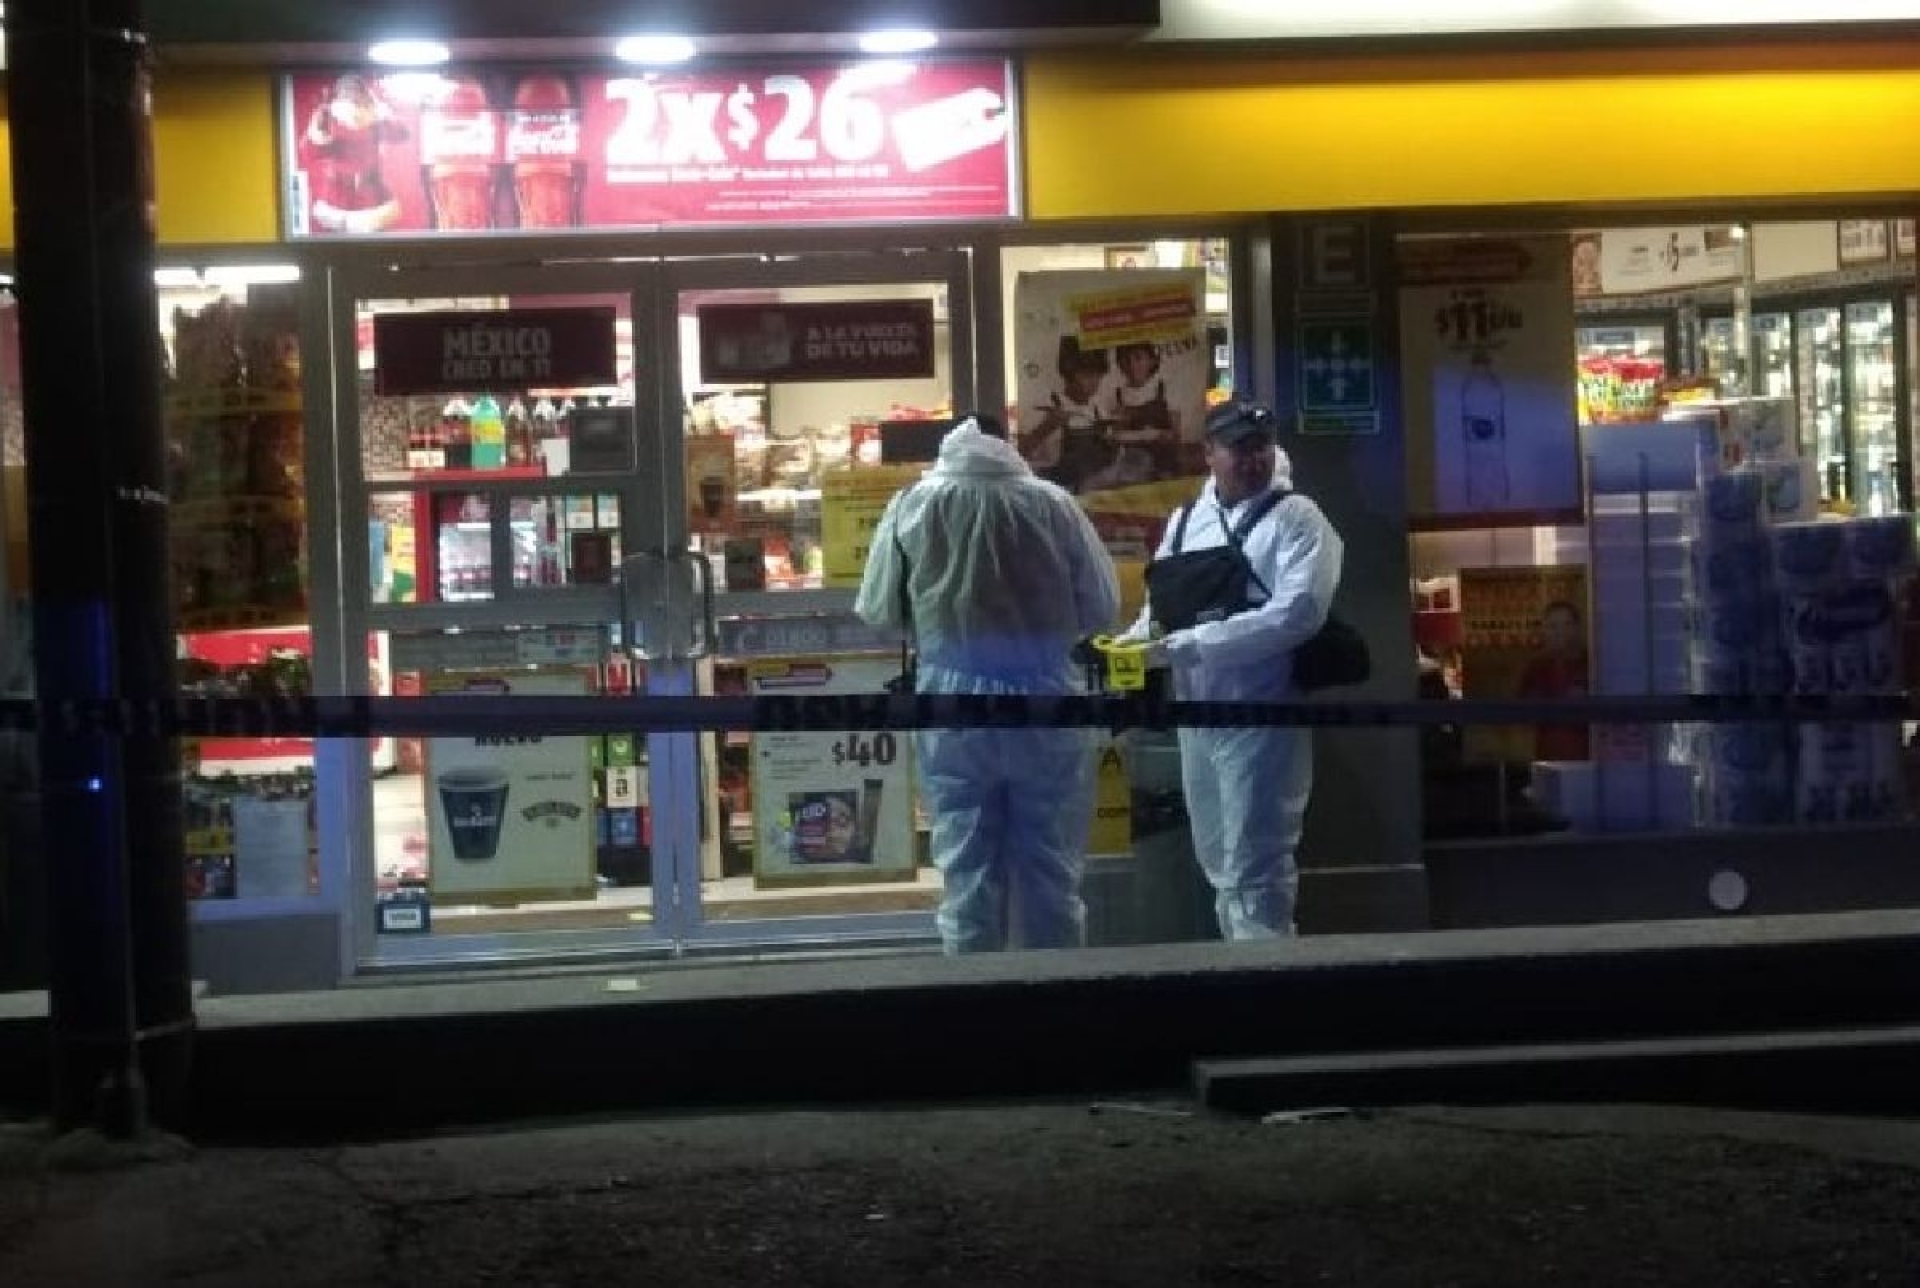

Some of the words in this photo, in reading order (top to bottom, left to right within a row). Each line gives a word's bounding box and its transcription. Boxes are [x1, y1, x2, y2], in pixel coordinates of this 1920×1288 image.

[1311, 227, 1355, 283] E
[442, 324, 552, 357] MÉXICO
[807, 342, 831, 359] DE
[835, 341, 863, 358] TU
[867, 338, 919, 356] VIDA
[831, 733, 897, 767] $40
